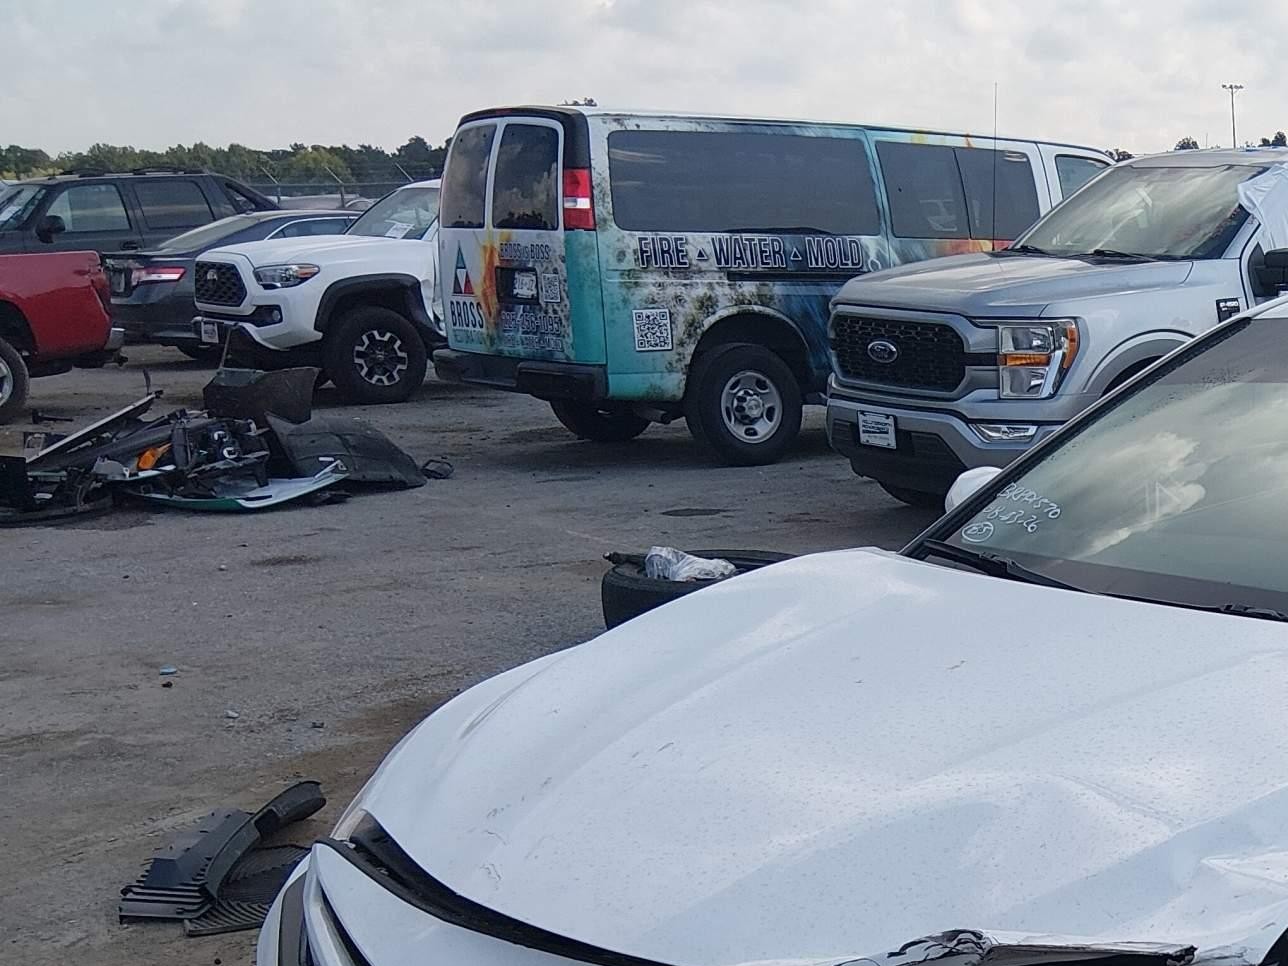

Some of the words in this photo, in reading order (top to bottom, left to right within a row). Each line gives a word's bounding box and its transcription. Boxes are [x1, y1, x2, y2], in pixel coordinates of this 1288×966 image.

[530, 243, 550, 260] BOSS
[638, 236, 689, 268] FIRE
[710, 236, 787, 269] WATER
[805, 237, 864, 269] MOLD
[450, 300, 484, 328] BROSS
